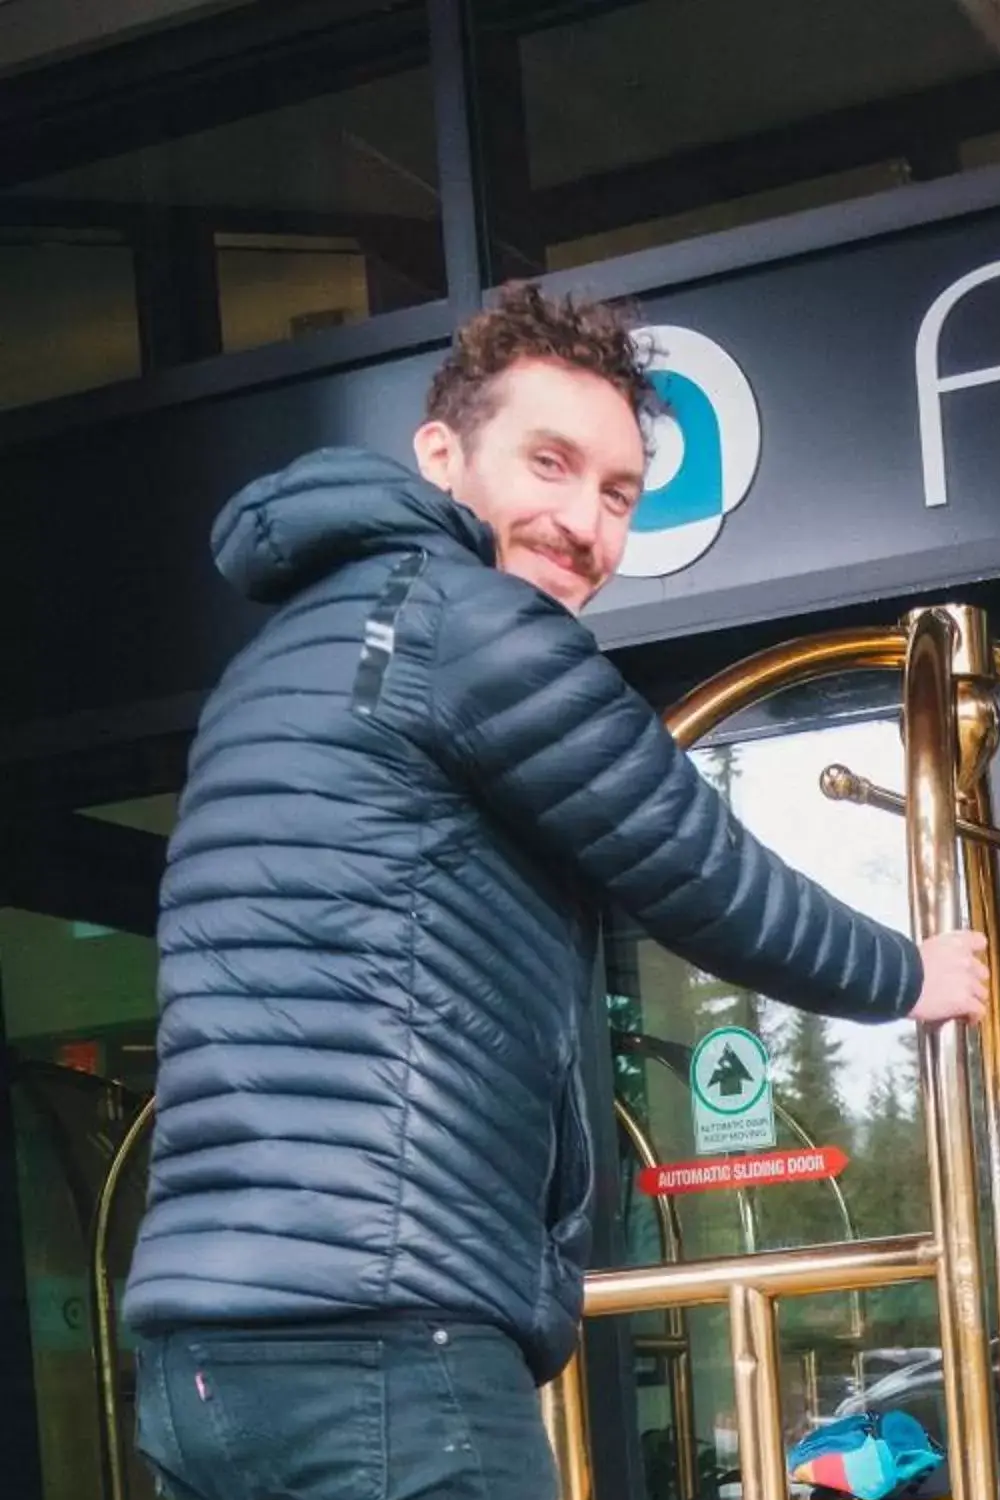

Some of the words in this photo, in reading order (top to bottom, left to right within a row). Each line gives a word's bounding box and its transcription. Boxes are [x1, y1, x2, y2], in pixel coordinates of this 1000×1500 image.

[658, 1166, 730, 1187] AUTOMATIC
[733, 1159, 785, 1180] SLIDING
[787, 1155, 825, 1173] DOOR
